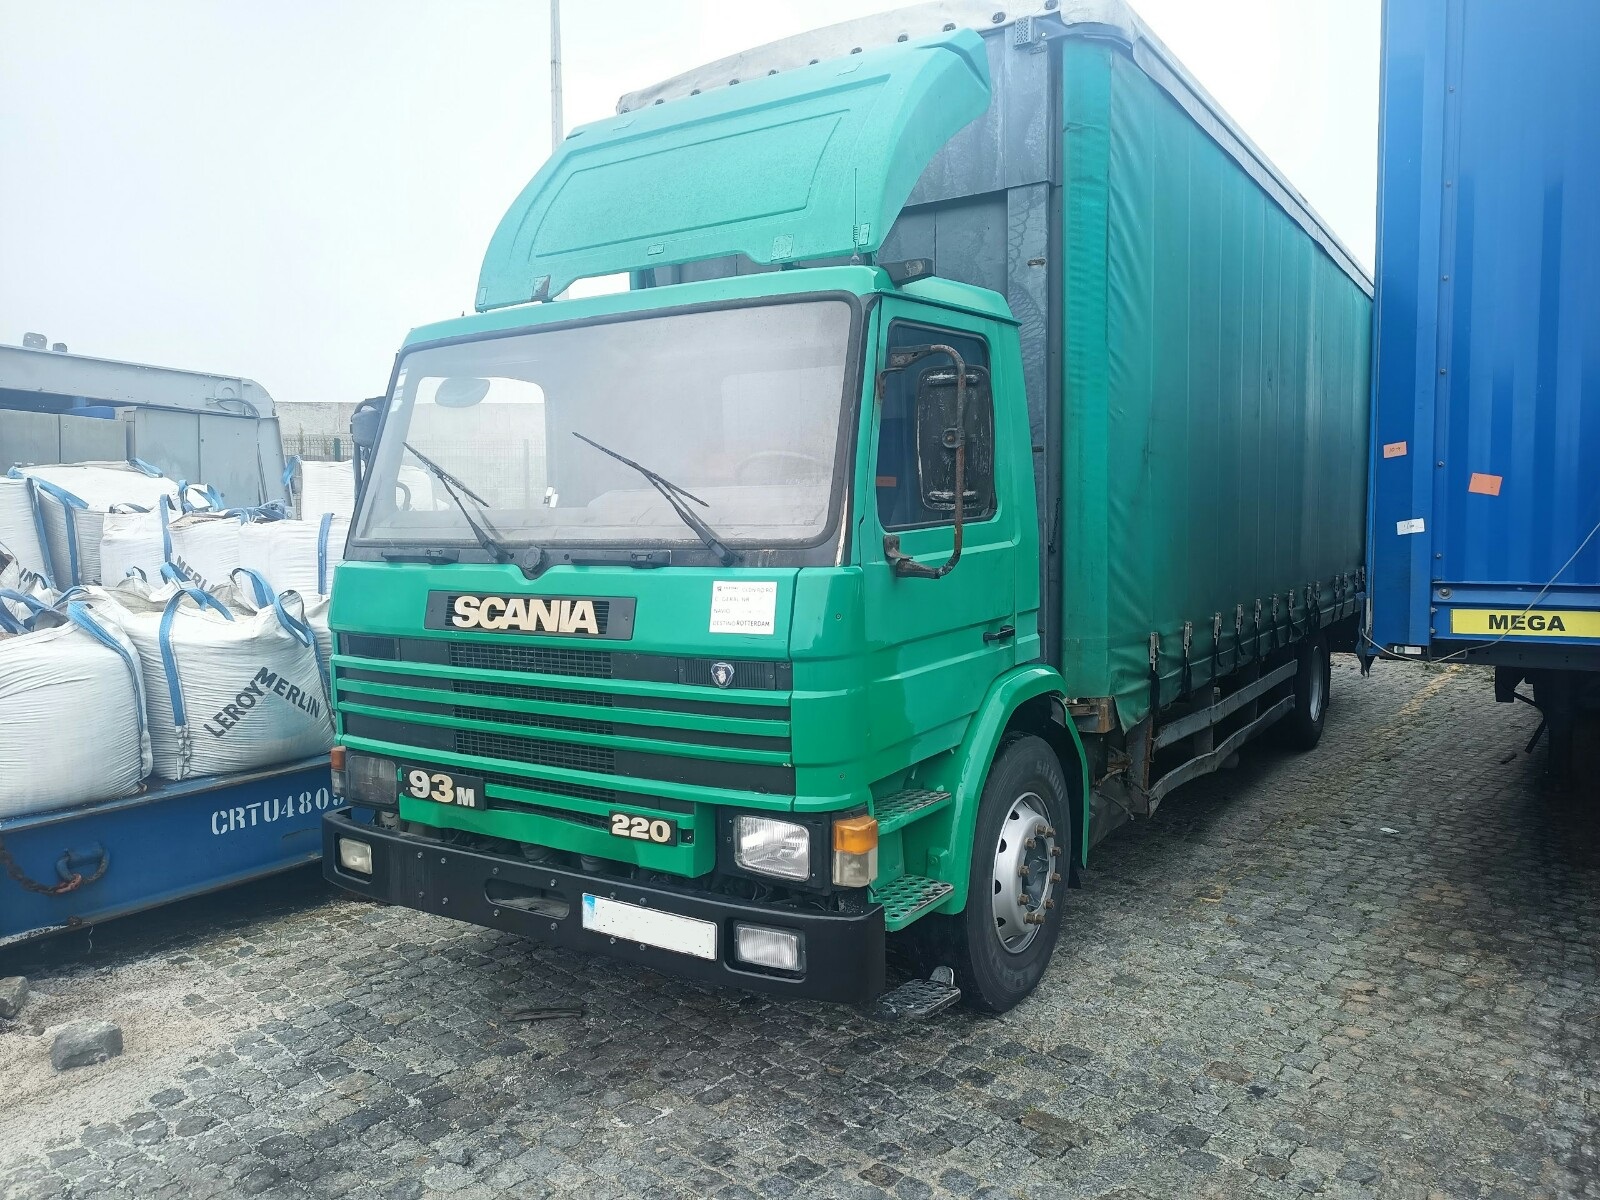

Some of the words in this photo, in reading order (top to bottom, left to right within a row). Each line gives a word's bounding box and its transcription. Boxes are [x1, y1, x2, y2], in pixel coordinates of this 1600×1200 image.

[452, 595, 599, 634] SCANIA
[1488, 614, 1566, 632] MEGA
[203, 679, 265, 738] LEROY
[253, 666, 321, 719] MERLIN
[409, 770, 455, 803] 93
[456, 786, 476, 808] M
[611, 813, 671, 843] 220
